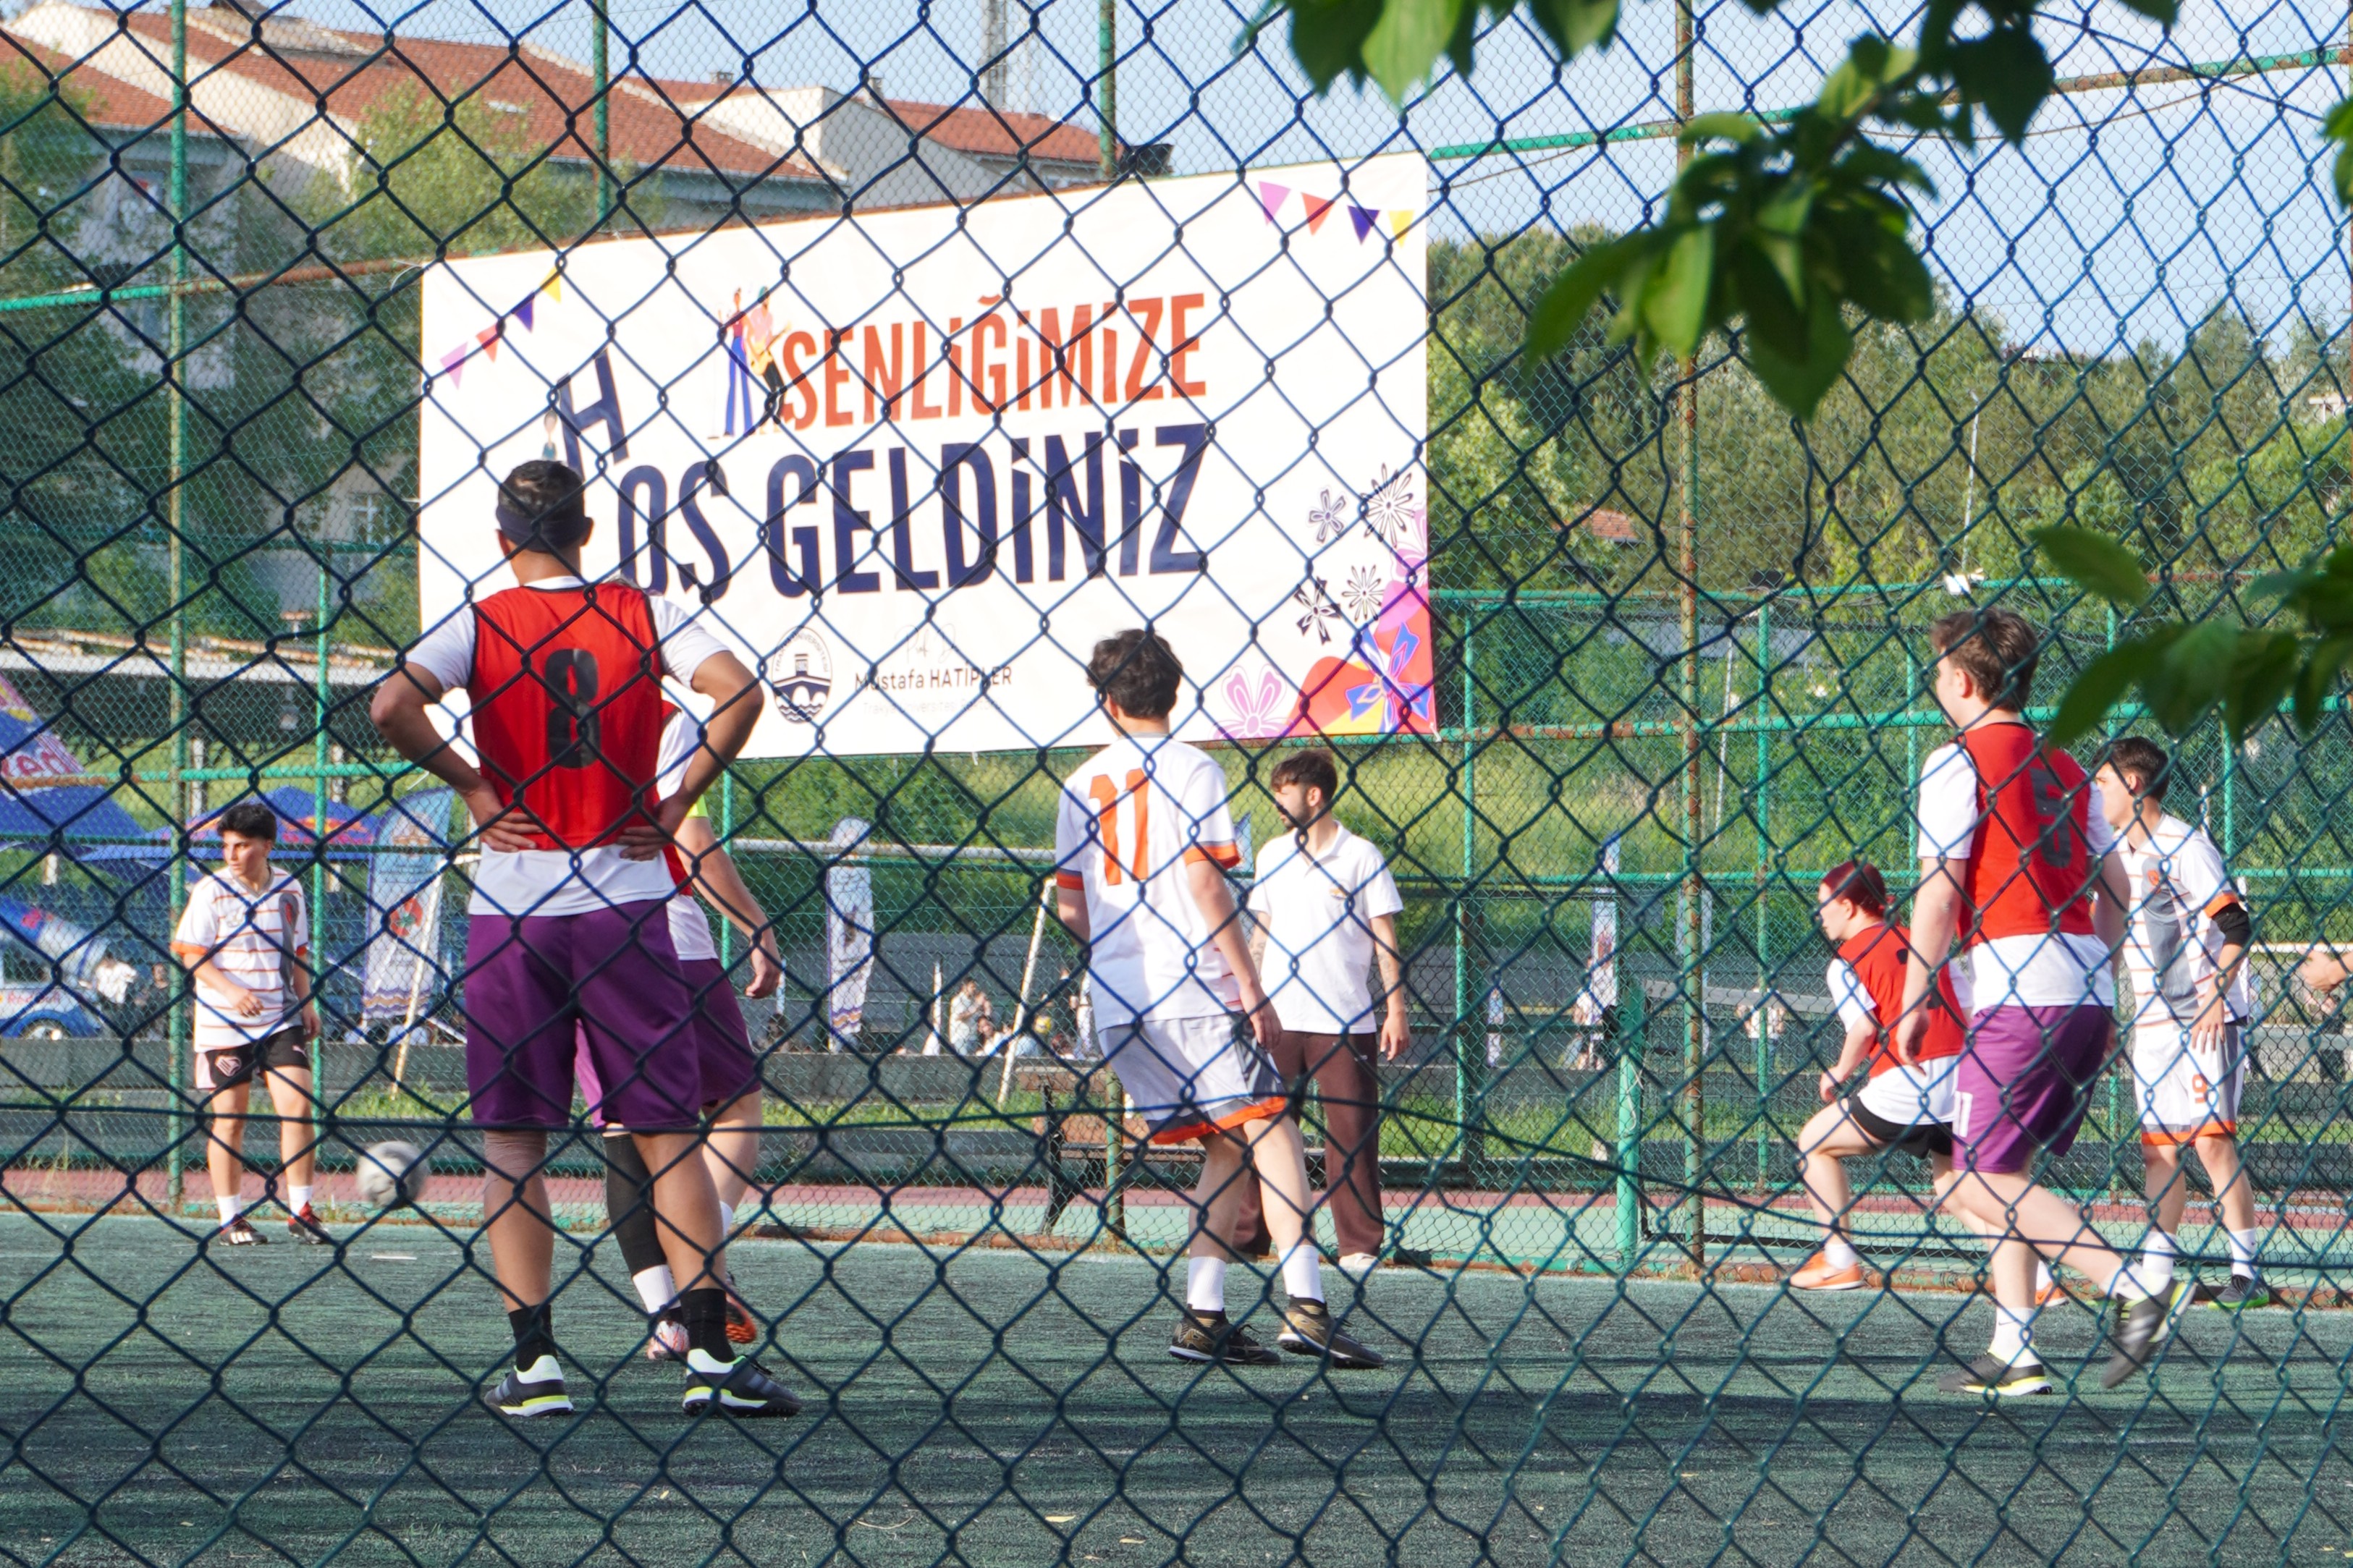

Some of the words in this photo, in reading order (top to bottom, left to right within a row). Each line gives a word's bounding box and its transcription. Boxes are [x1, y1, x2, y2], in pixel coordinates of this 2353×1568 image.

[766, 422, 1207, 598] GELDİNİZ
[545, 648, 601, 769] 8
[1089, 768, 1149, 886] 11
[2029, 767, 2072, 868] 5
[2192, 1073, 2209, 1104] 9
